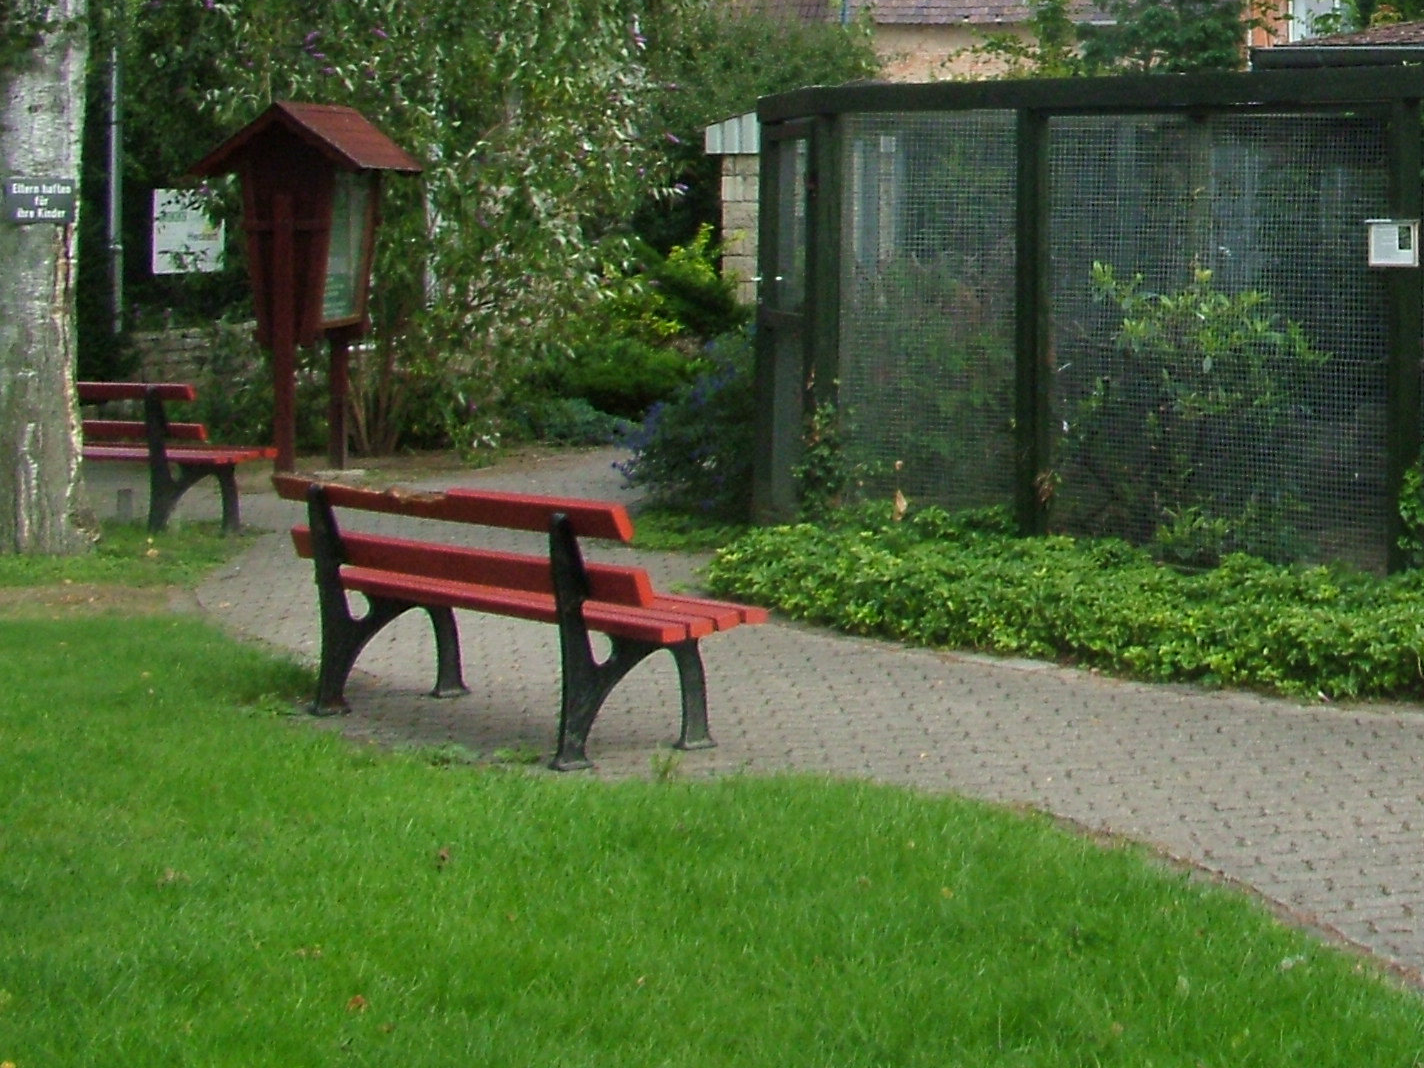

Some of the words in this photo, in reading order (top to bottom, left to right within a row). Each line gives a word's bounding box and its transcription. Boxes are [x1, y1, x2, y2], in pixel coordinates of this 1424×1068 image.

[12, 183, 39, 194] Eltern
[42, 183, 71, 194] haften
[34, 195, 49, 206] für
[37, 207, 66, 218] Kinder
